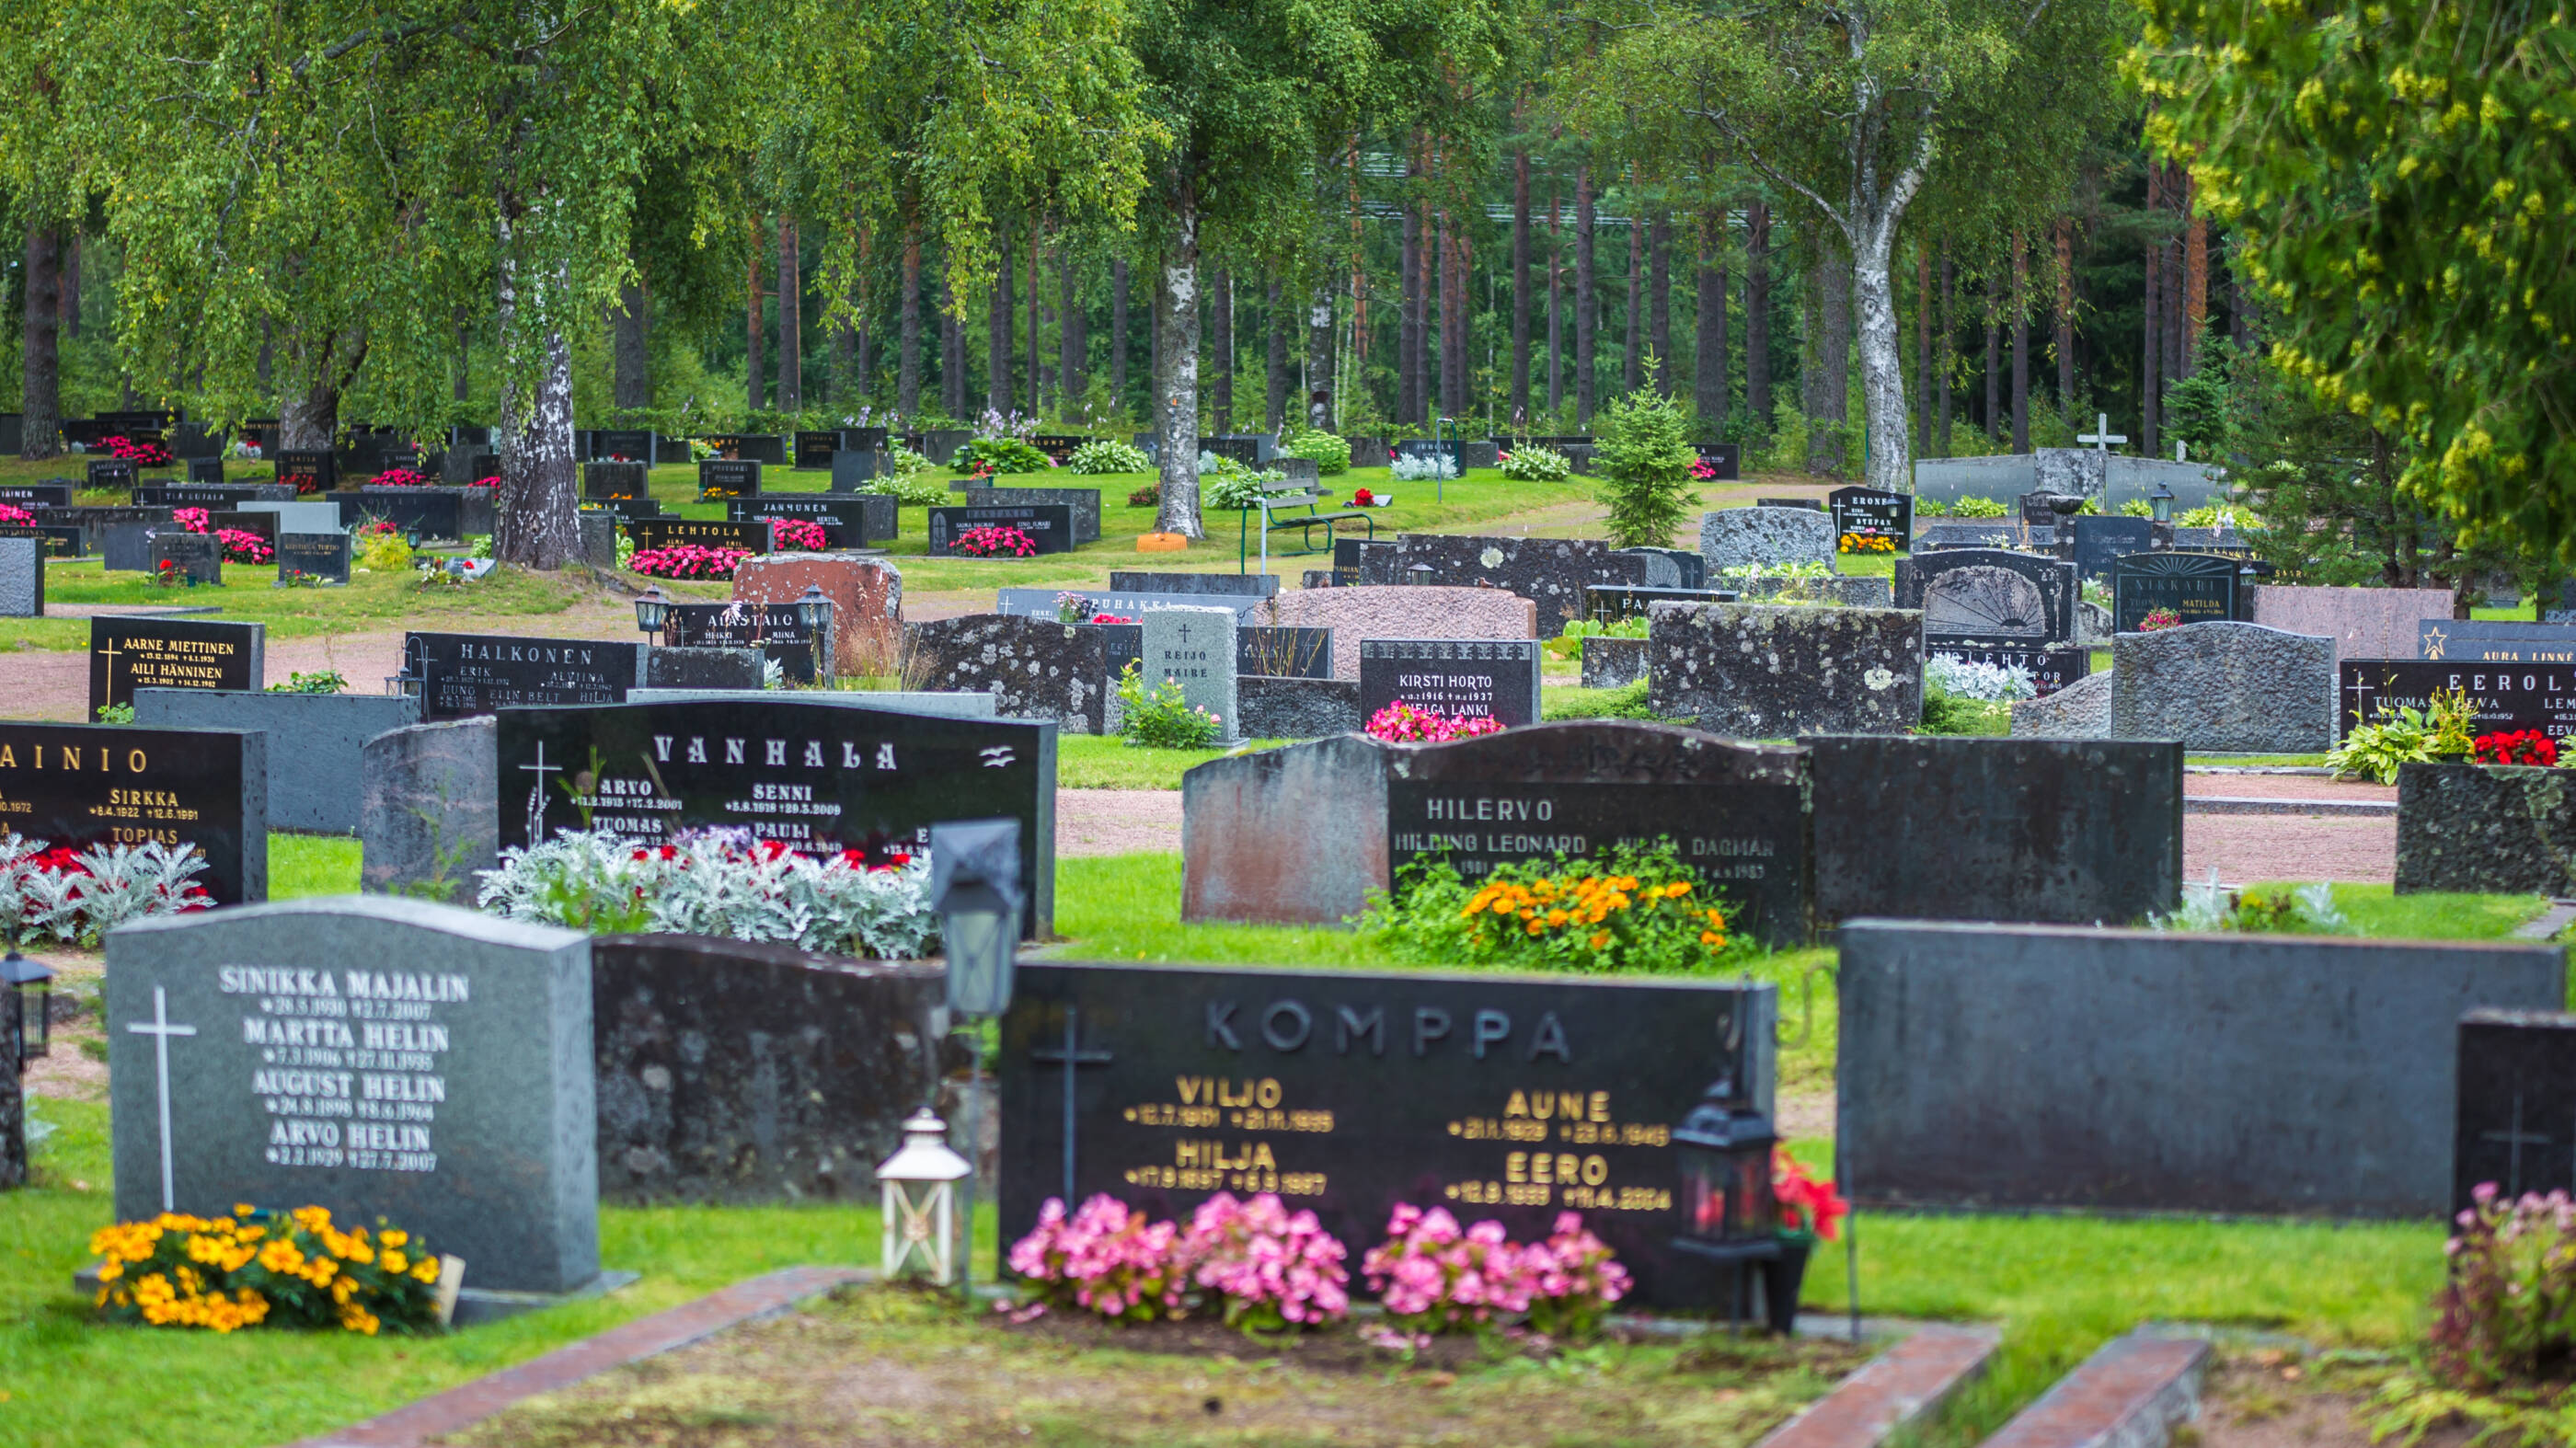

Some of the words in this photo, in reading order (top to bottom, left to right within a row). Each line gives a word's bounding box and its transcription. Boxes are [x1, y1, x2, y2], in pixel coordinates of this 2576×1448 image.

[764, 503, 828, 512] JANHUNEN
[668, 524, 740, 536] LEHTOLA
[1623, 598, 1650, 609] PA
[2182, 600, 2220, 608] MATILDA
[123, 638, 164, 651] AARNE
[168, 640, 235, 655] MIETTINEN
[461, 644, 592, 665] HALKONEN
[1165, 651, 1207, 661] REIJO
[2483, 651, 2519, 661] AURA
[131, 663, 155, 675] AILI
[160, 663, 223, 679] HÄNNINEN
[460, 666, 493, 677] ERIK
[552, 672, 604, 684] ALVIINA
[1165, 669, 1207, 678] MAIRE
[443, 684, 477, 695] UUNO
[1400, 675, 1444, 688] KIRSTI
[1449, 675, 1492, 690] HORTO
[2450, 674, 2576, 691] EEROL
[528, 692, 559, 703] BELT
[580, 692, 613, 703] HILJA
[2374, 696, 2433, 708] TUOMAS
[1452, 705, 1489, 716] LANKI
[2548, 725, 2576, 736] EEV
[0, 744, 147, 773] AINIO
[654, 736, 897, 770] VANHALA
[601, 779, 652, 796] ARVO
[753, 784, 812, 801] SENNI
[110, 788, 178, 807] SIRKKA
[1428, 799, 1553, 821] HILERVO
[592, 817, 662, 833] TUOMAS
[754, 822, 810, 839] PAULI
[112, 827, 178, 845] TOPIAS
[1487, 833, 1586, 854] LEONARD
[1693, 836, 1774, 856] DAGMAR
[219, 964, 337, 996] SINIKKA
[346, 969, 469, 1003] MAJALIN
[243, 1017, 355, 1047] MARTTA
[362, 1020, 449, 1052] HELIN
[1205, 999, 1570, 1063] KOMPPA
[252, 1068, 354, 1097] AUGUST
[362, 1072, 445, 1102] HELIN
[1176, 1075, 1282, 1109] VILJO
[1503, 1089, 1611, 1122] AUNE
[270, 1119, 340, 1148] ARVO
[346, 1120, 431, 1152] HELIN
[1176, 1139, 1277, 1172] HILJA
[1506, 1152, 1608, 1187] EERO
